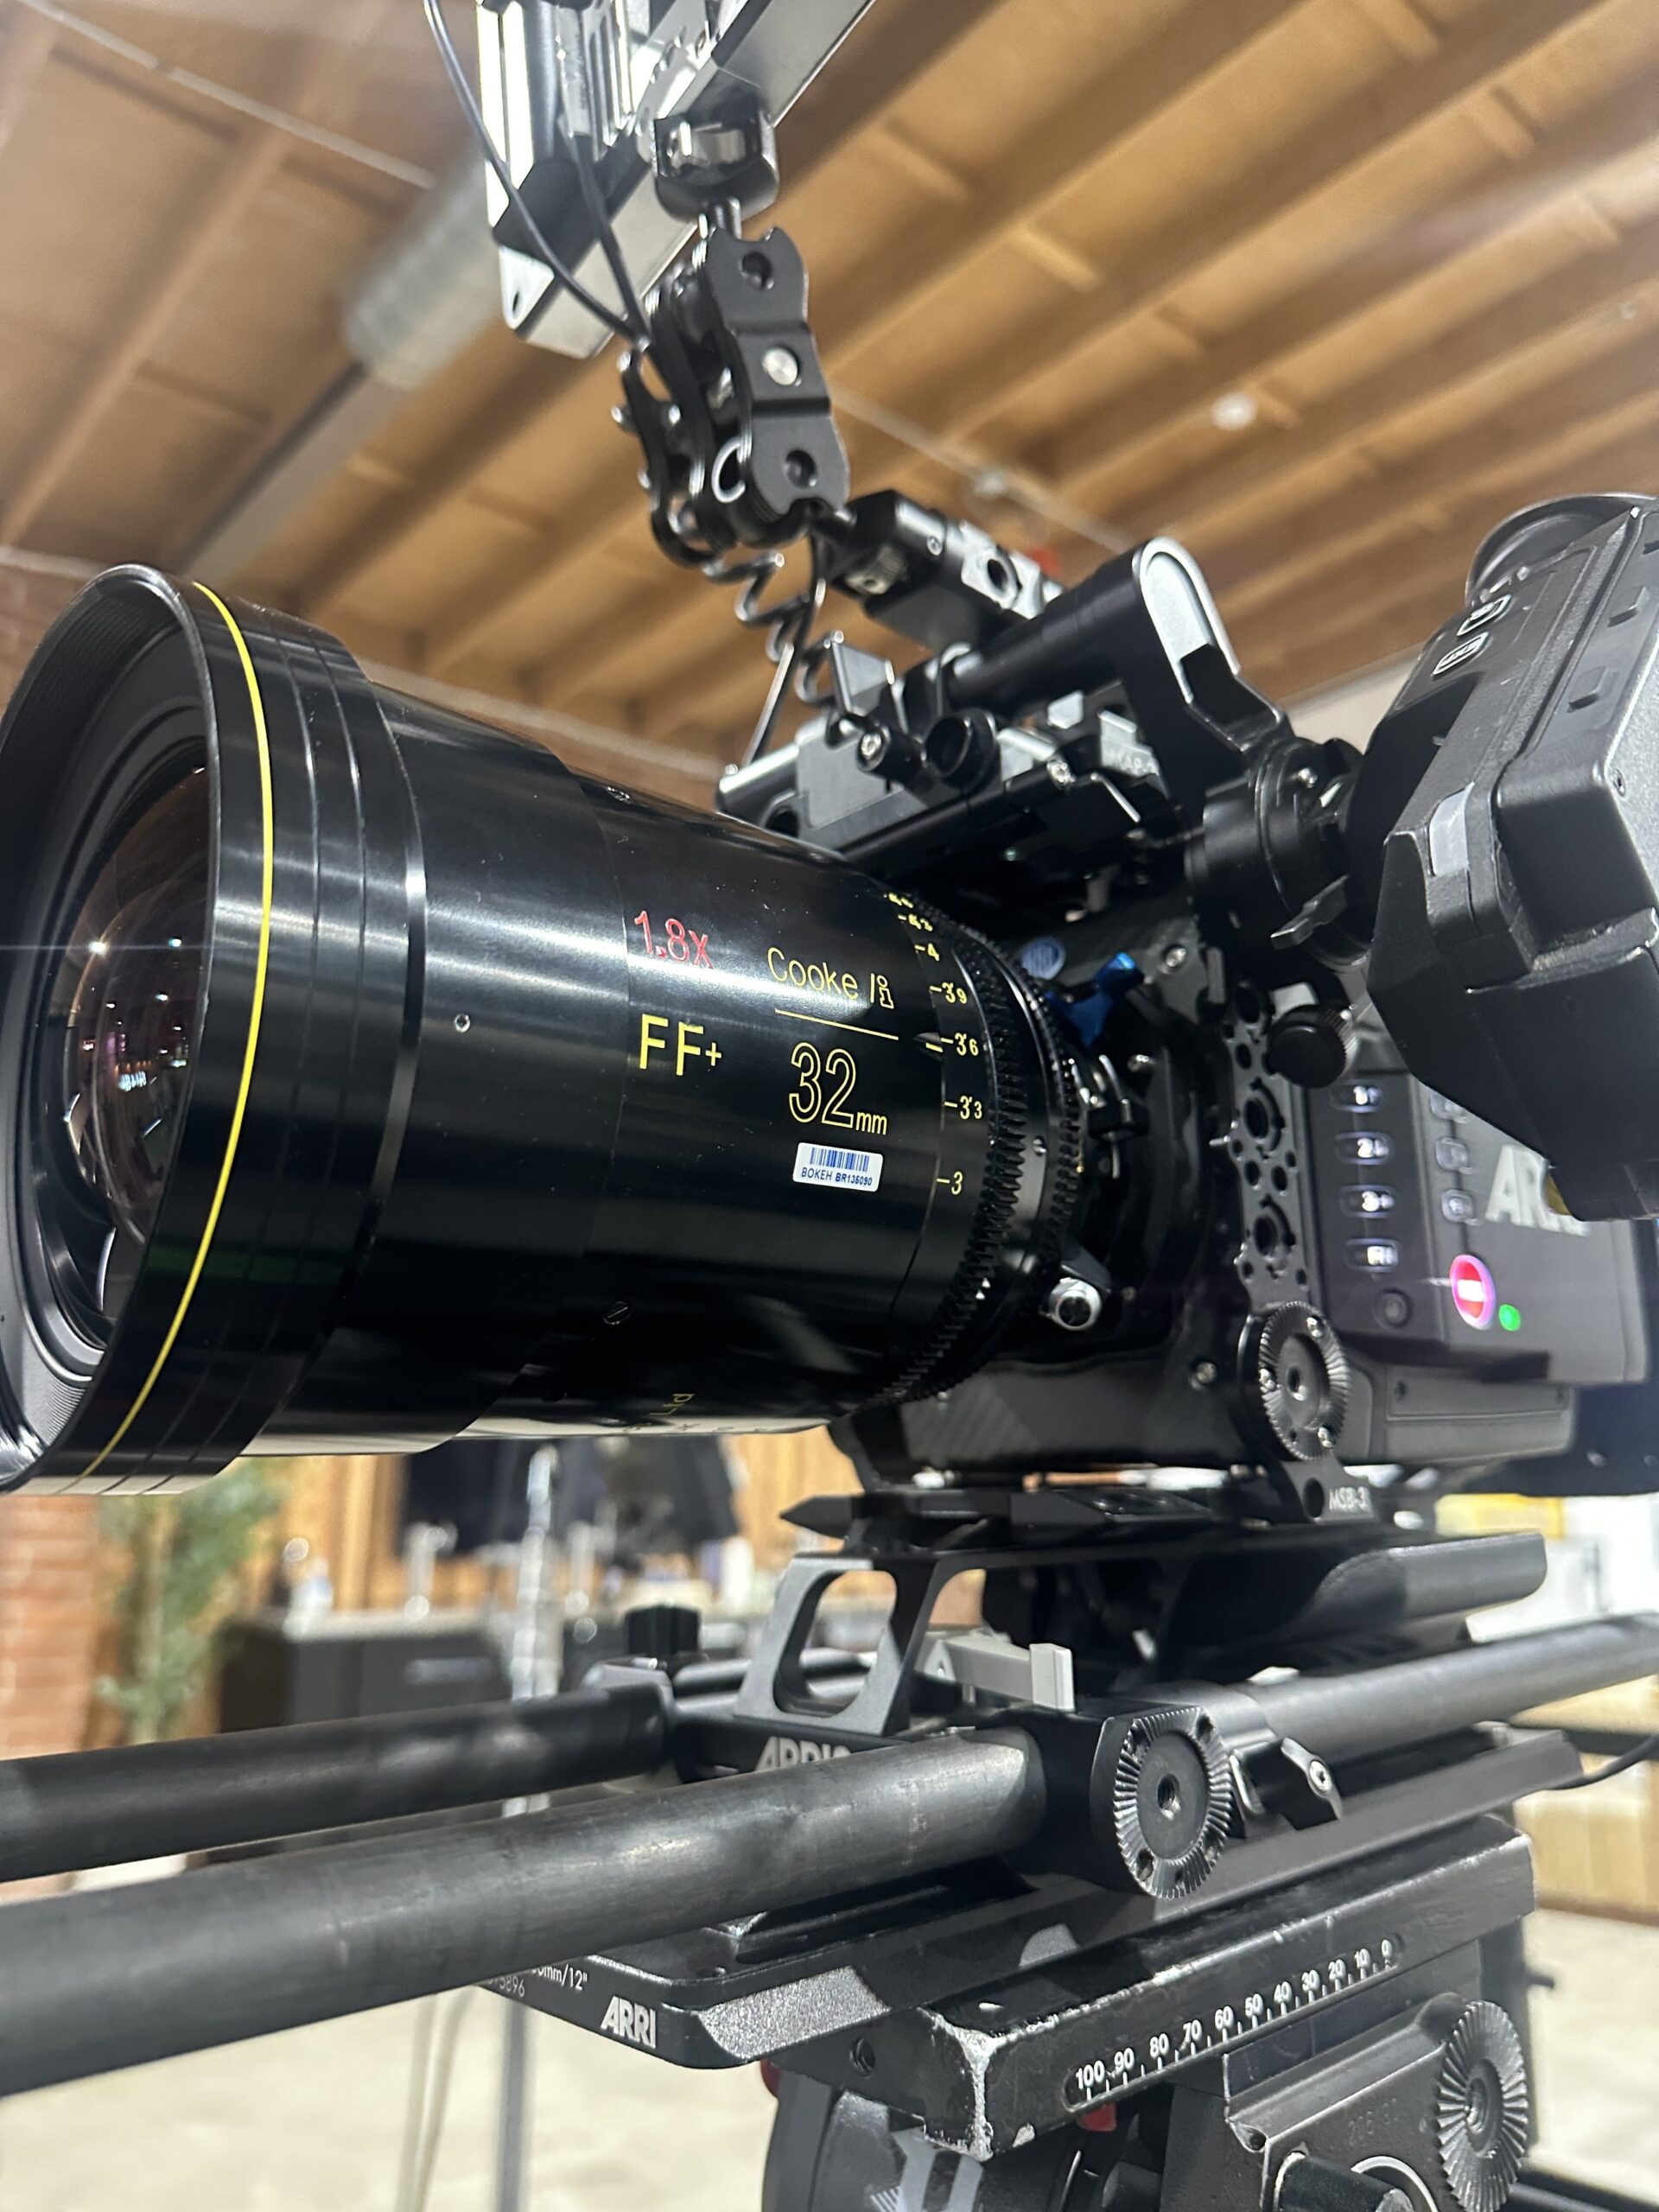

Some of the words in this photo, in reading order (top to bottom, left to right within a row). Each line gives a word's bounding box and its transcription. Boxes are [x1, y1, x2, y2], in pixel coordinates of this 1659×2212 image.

[766, 947, 858, 999] Cooke
[639, 1013, 722, 1076] FF+
[788, 1042, 888, 1135] 32mm
[801, 1166, 832, 1181] BOKEH
[950, 1171, 963, 1195] 3
[1328, 1485, 1370, 1512] MSB-3
[601, 1995, 657, 2050] ARRI
[1076, 2060, 1105, 2089] 100
[1113, 2046, 1135, 2074] 90
[1149, 2032, 1170, 2057] 80
[1181, 2019, 1203, 2041] 70
[1214, 2005, 1235, 2028] 60
[1244, 1993, 1264, 2016] 50
[1274, 1981, 1293, 2003] 40
[1301, 1969, 1320, 1991] 30
[1328, 1959, 1346, 1980] 20
[1353, 1948, 1371, 1968] 10
[1382, 1939, 1392, 1957] 0
